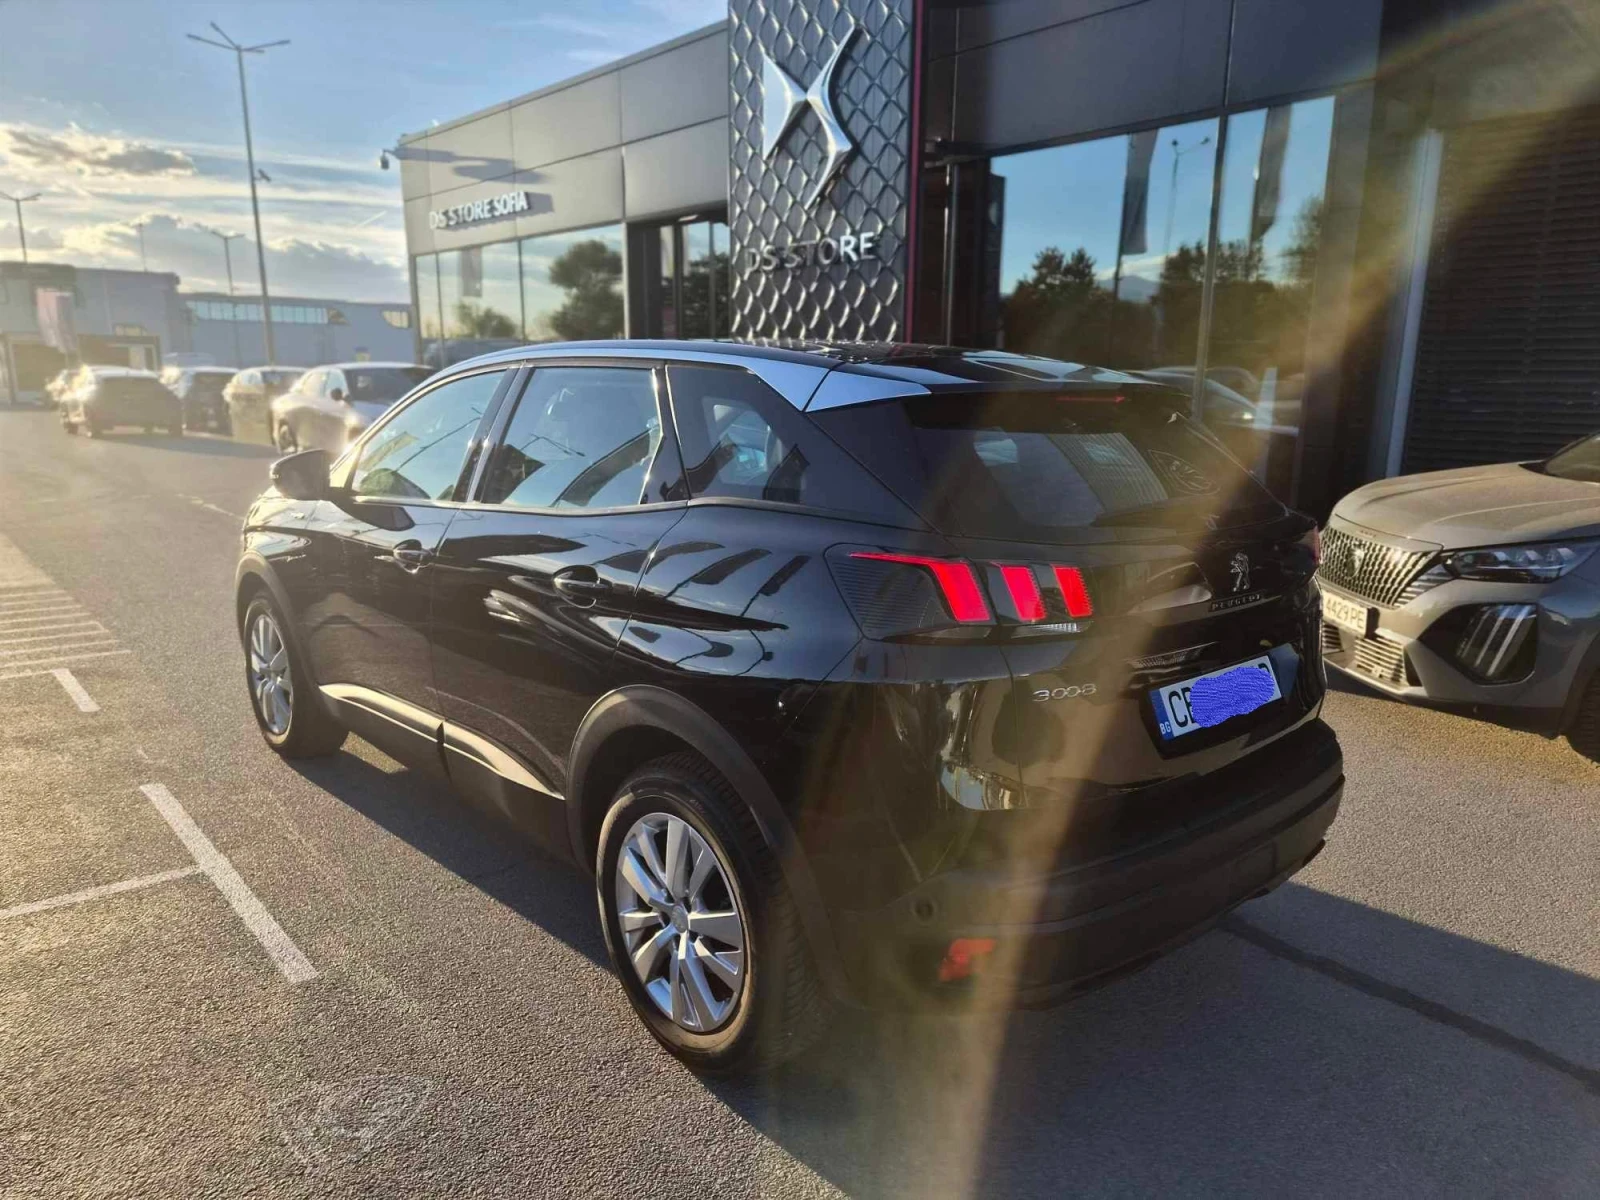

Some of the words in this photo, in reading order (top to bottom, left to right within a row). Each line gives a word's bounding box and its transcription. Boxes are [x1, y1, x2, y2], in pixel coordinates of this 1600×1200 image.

[429, 209, 448, 230] DS
[448, 198, 492, 226] STORE
[493, 190, 528, 217] SOFIA
[743, 245, 779, 273] DS
[783, 231, 876, 268] STORE
[1032, 683, 1097, 702] 3008
[1159, 721, 1171, 735] BG
